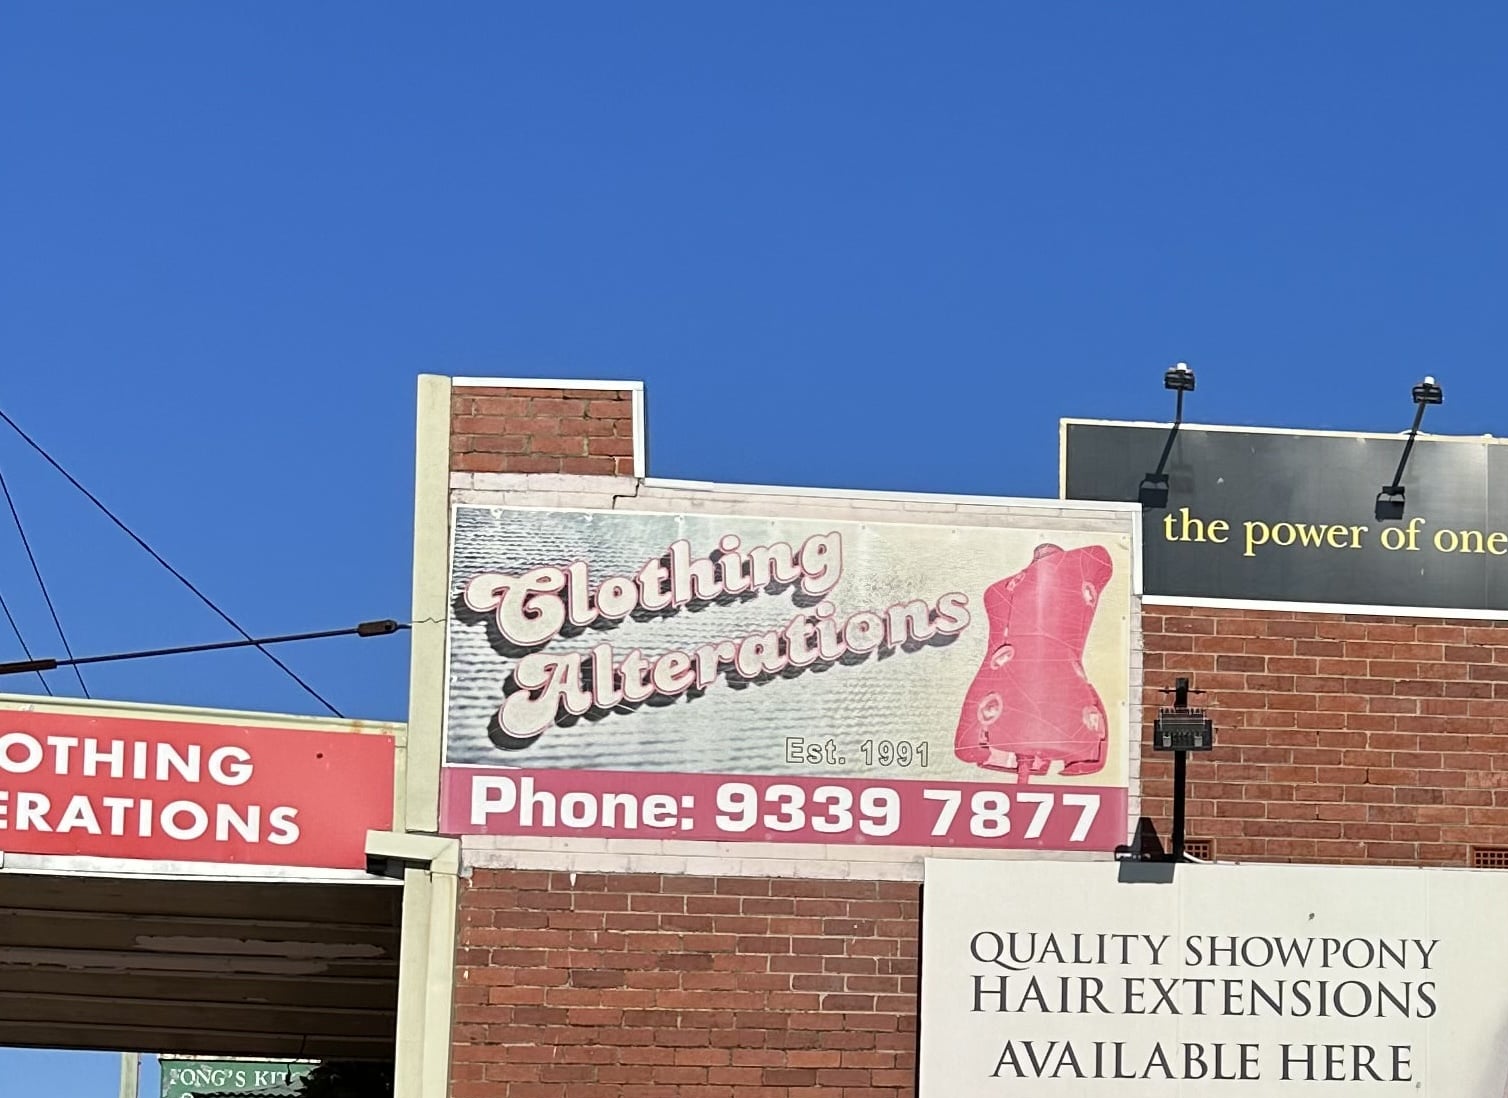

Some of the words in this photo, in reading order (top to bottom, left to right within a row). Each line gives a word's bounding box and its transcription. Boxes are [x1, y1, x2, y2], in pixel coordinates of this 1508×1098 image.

[1163, 508, 1229, 545] the
[1243, 515, 1369, 557] power
[1379, 517, 1425, 552] of
[465, 531, 843, 647] Clothing
[499, 591, 971, 739] Alterations
[785, 736, 845, 765] Est.
[861, 740, 930, 768] 1991
[469, 776, 693, 830] Phone:
[716, 783, 900, 836] 9339
[924, 789, 1101, 841] 7877
[970, 931, 1171, 971] QUALITY
[1185, 935, 1441, 970] SHOWPONY
[970, 974, 1114, 1014] HAIR
[1121, 977, 1438, 1019] EXTENSIONS
[989, 1039, 1261, 1081] AVAILABLE
[1279, 1043, 1413, 1082] HERE
